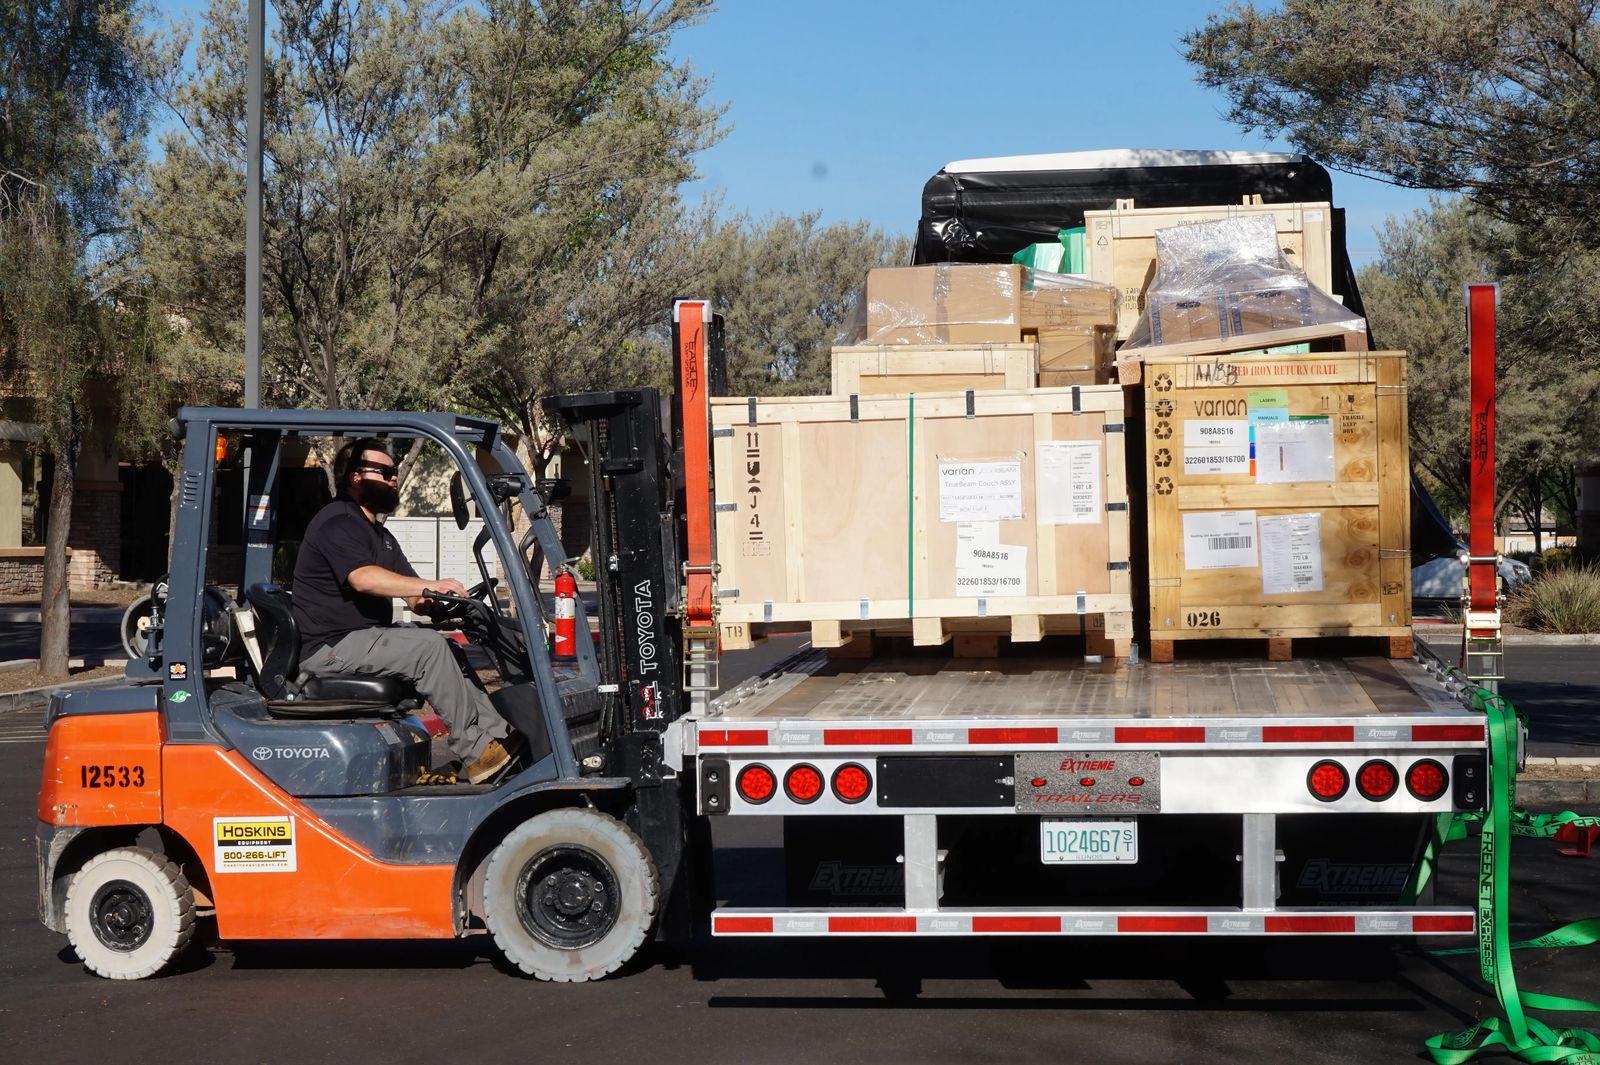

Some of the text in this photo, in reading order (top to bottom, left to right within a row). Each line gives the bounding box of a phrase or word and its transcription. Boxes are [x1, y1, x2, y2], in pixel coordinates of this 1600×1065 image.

[689, 342, 698, 388] EAGLE
[1232, 364, 1338, 377] RED IRON RETURN CRATE
[1194, 398, 1248, 416] varian
[1184, 456, 1246, 464] 322601853/16700
[973, 550, 1009, 560] 908A8516
[957, 577, 1020, 586] 322601853/16700
[1186, 610, 1221, 628] 026
[634, 580, 658, 675] TOYOTA
[724, 626, 743, 638] T13
[170, 663, 186, 674] SAS
[275, 748, 330, 758] TOYOTA
[1059, 758, 1116, 772] EXTREME
[81, 765, 145, 788] 12533
[1034, 794, 1142, 804] TRAILERS
[223, 826, 286, 837] HOSKINS
[1047, 830, 1120, 853] 1024667
[813, 863, 904, 892] EXTREM
[1480, 831, 1493, 966] FREENET EXPRESS
